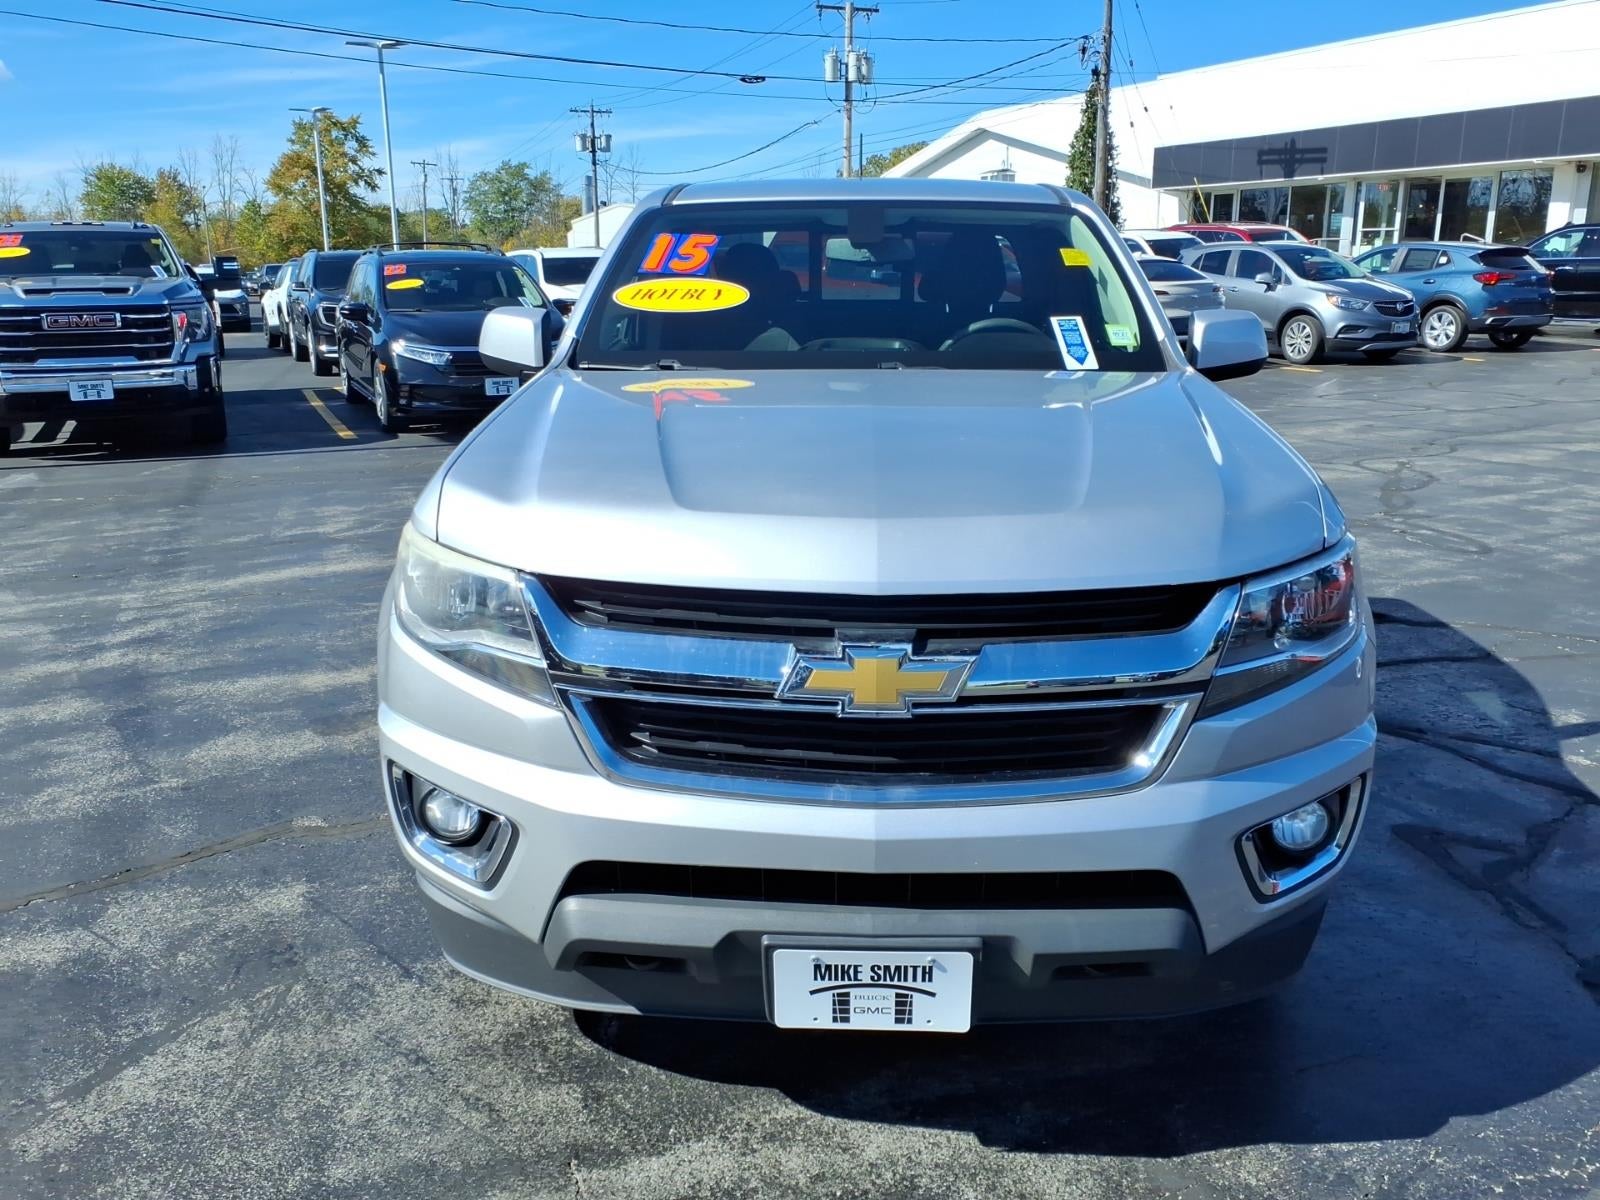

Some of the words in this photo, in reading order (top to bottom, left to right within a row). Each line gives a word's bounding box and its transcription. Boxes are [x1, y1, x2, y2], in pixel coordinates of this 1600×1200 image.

[642, 232, 718, 273] 15
[630, 288, 677, 300] HOT
[680, 288, 725, 300] BUY
[47, 315, 116, 328] GMC
[813, 964, 863, 981] MIKE
[870, 964, 933, 983] SMITH
[853, 1006, 892, 1015] GMC
